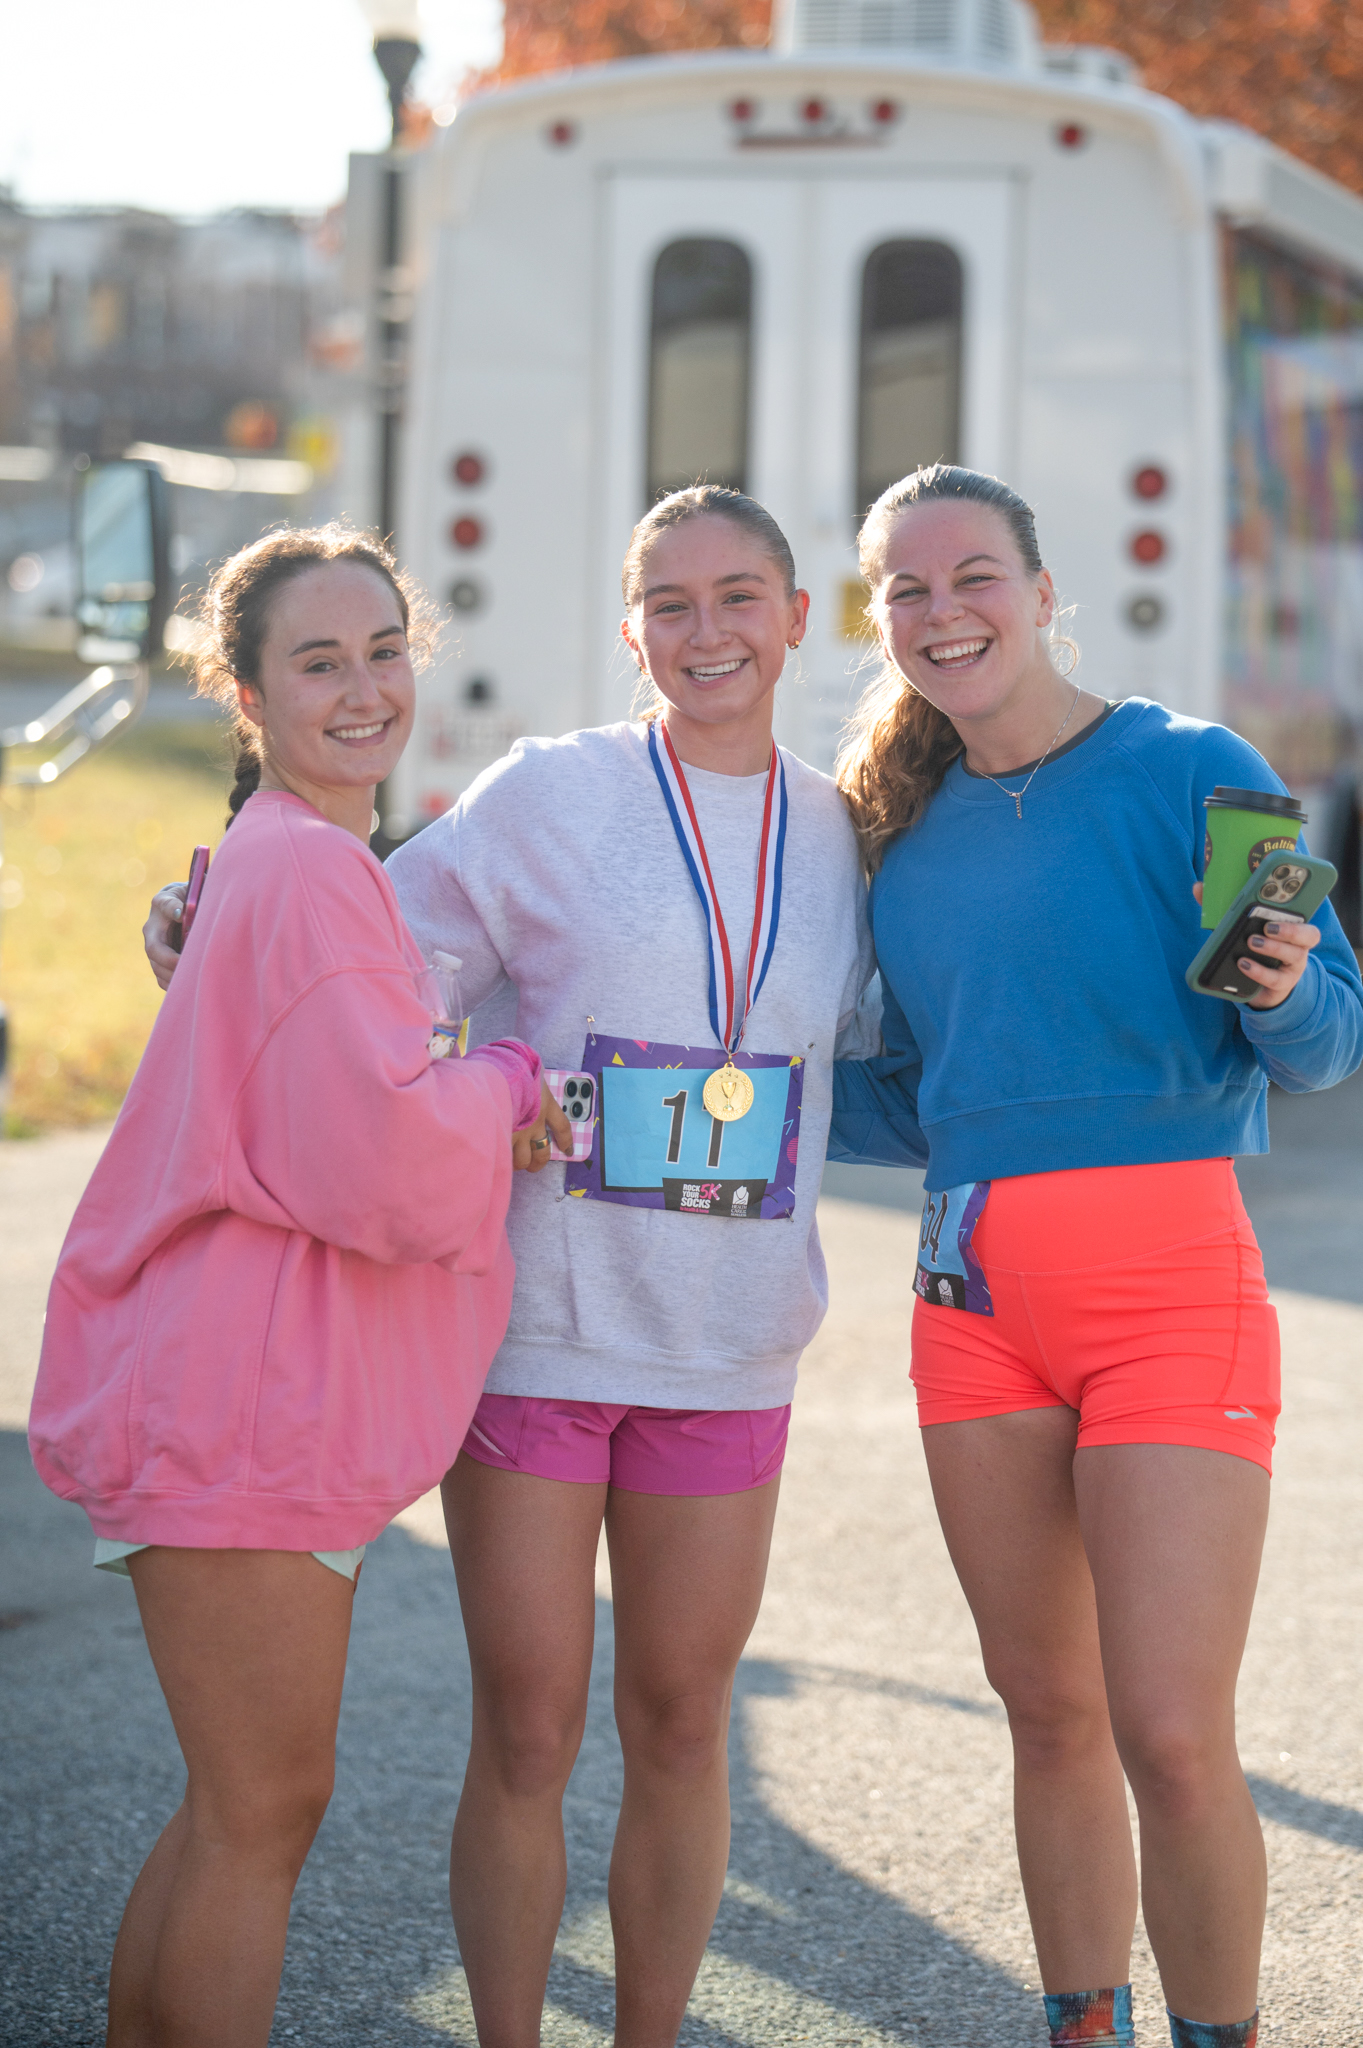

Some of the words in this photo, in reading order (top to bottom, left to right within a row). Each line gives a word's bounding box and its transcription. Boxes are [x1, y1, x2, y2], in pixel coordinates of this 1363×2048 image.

[683, 1183, 700, 1192] ROCK
[700, 1183, 722, 1201] 5K
[682, 1191, 700, 1199] YOUR
[681, 1197, 711, 1209] SOCKS
